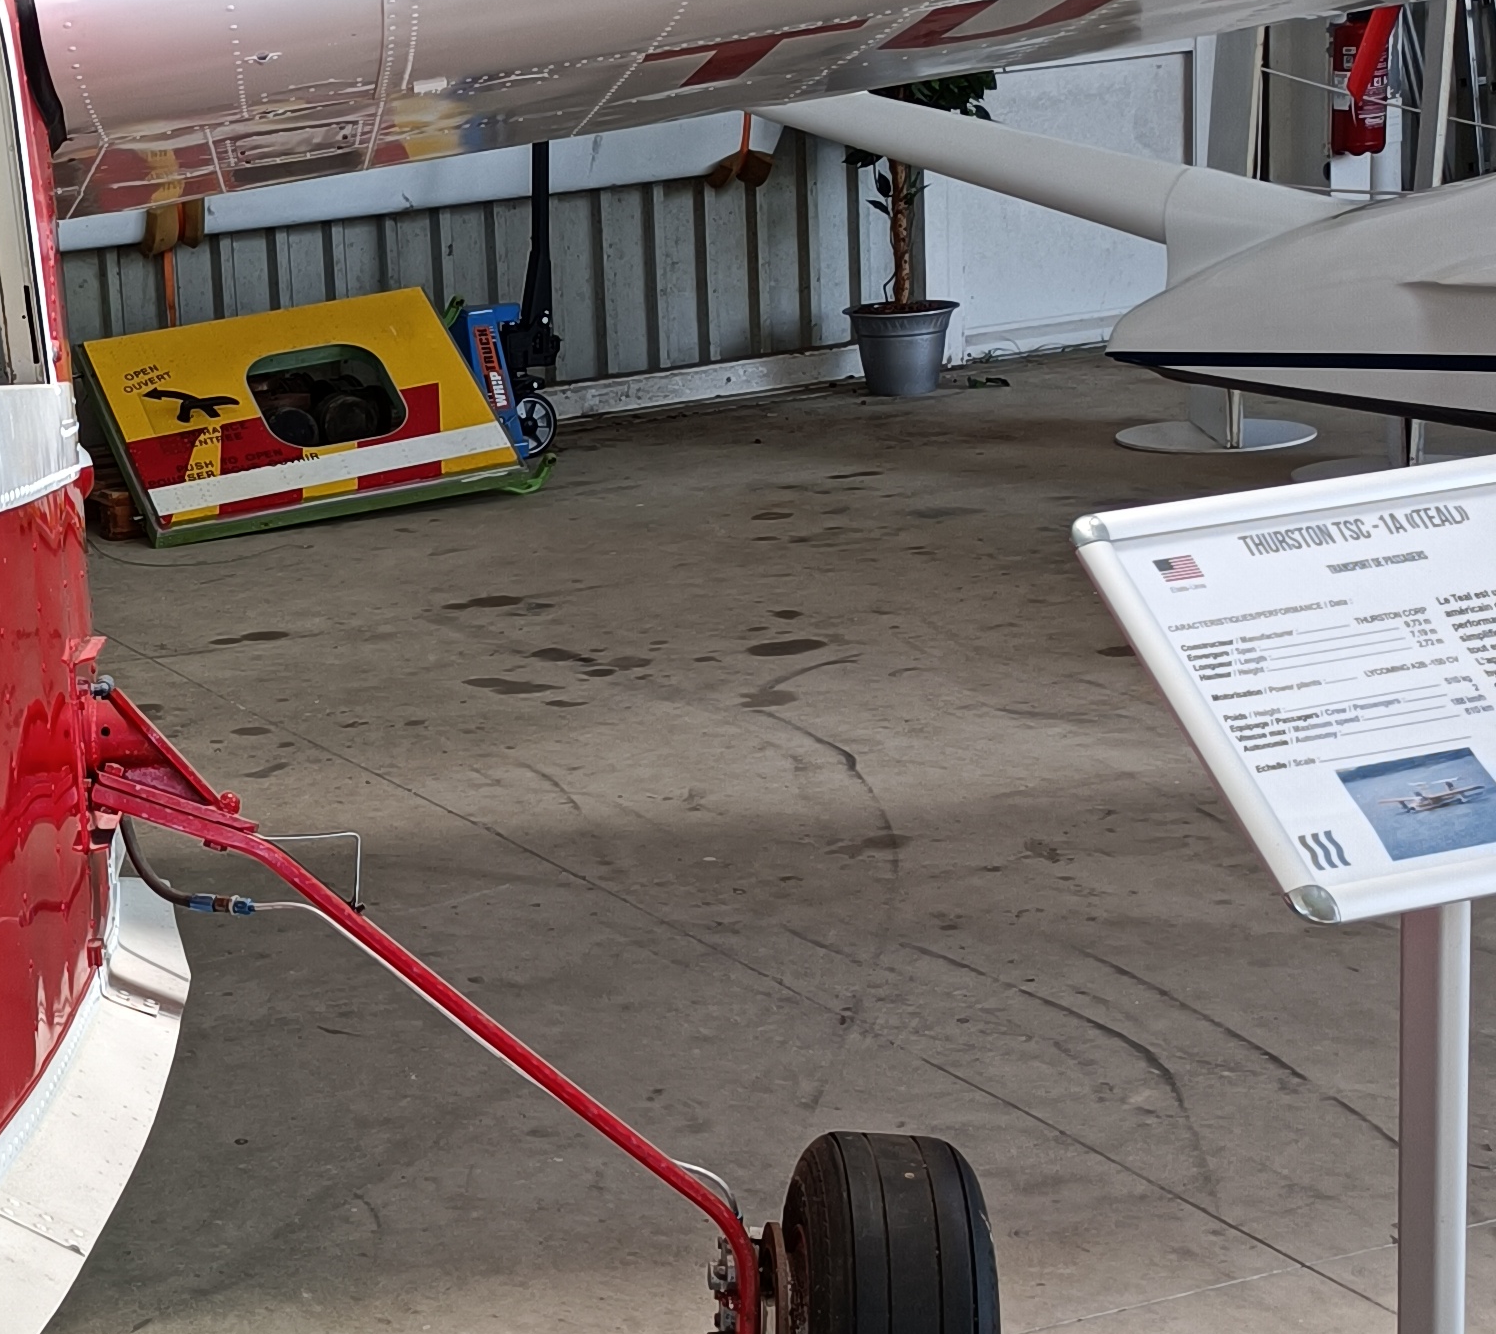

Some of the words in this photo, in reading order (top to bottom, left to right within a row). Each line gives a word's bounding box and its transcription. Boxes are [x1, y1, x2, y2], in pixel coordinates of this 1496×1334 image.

[123, 371, 172, 393] OUVERT
[124, 364, 159, 381] OPEN
[176, 460, 214, 473] PUSH
[245, 448, 283, 461] OPEN
[1237, 523, 1336, 557] THURSTON
[1331, 518, 1371, 542] TSC
[1378, 512, 1408, 535] 1A
[1449, 592, 1473, 603] Teal
[1354, 611, 1402, 626] THURSTON
[1402, 606, 1427, 617] CORP
